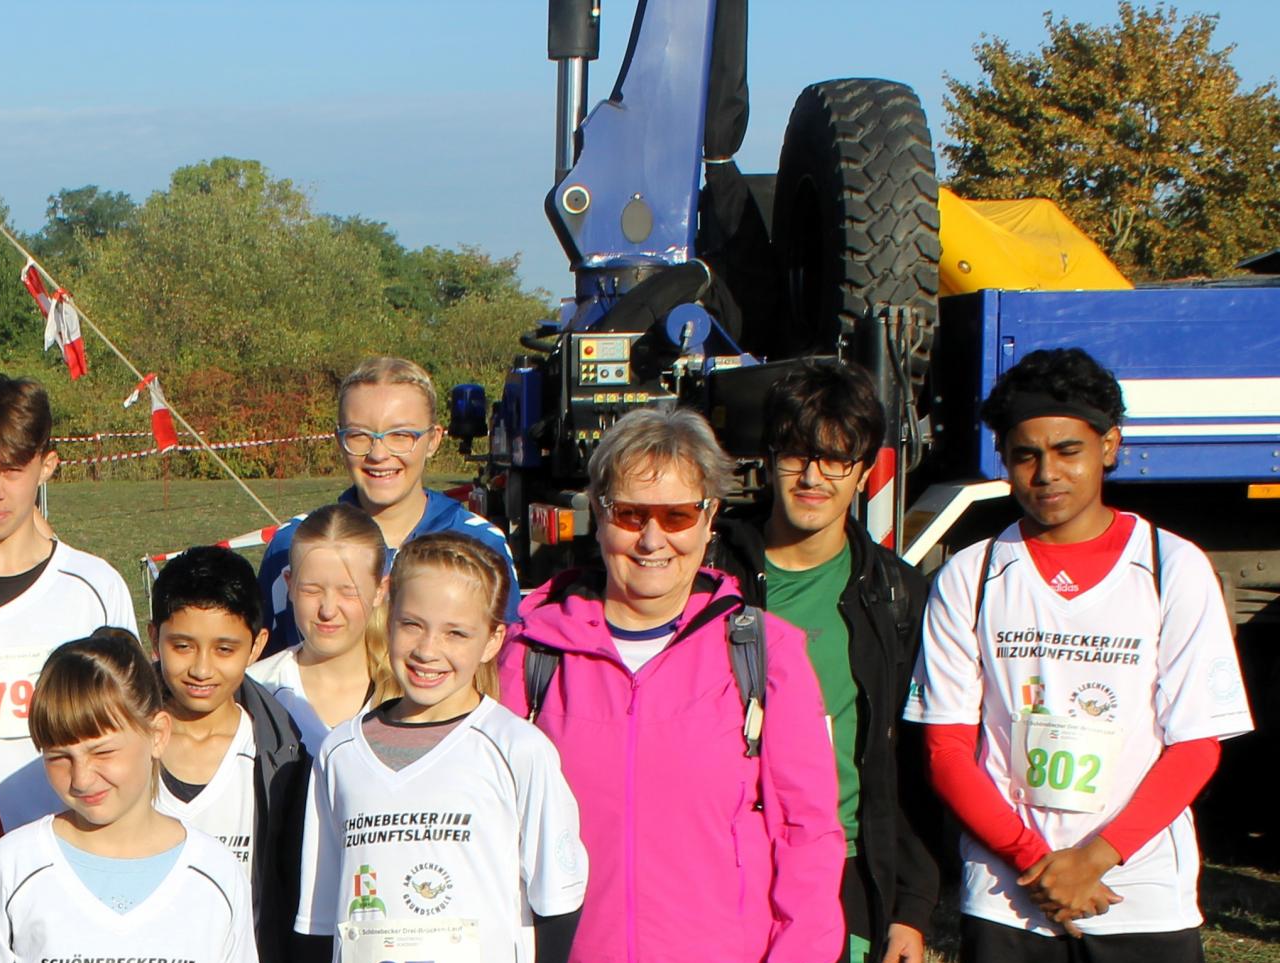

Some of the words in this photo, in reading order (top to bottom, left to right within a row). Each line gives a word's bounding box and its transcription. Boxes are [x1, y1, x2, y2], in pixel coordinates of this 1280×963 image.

[996, 627, 1111, 648] SCHÖNEBECKER
[1008, 646, 1140, 665] ZUKUNFTSLÄUFER
[1026, 748, 1101, 794] 802
[344, 812, 439, 832] CHÖNEBECKER
[346, 825, 470, 848] ZUKUNFTSLÄUFER
